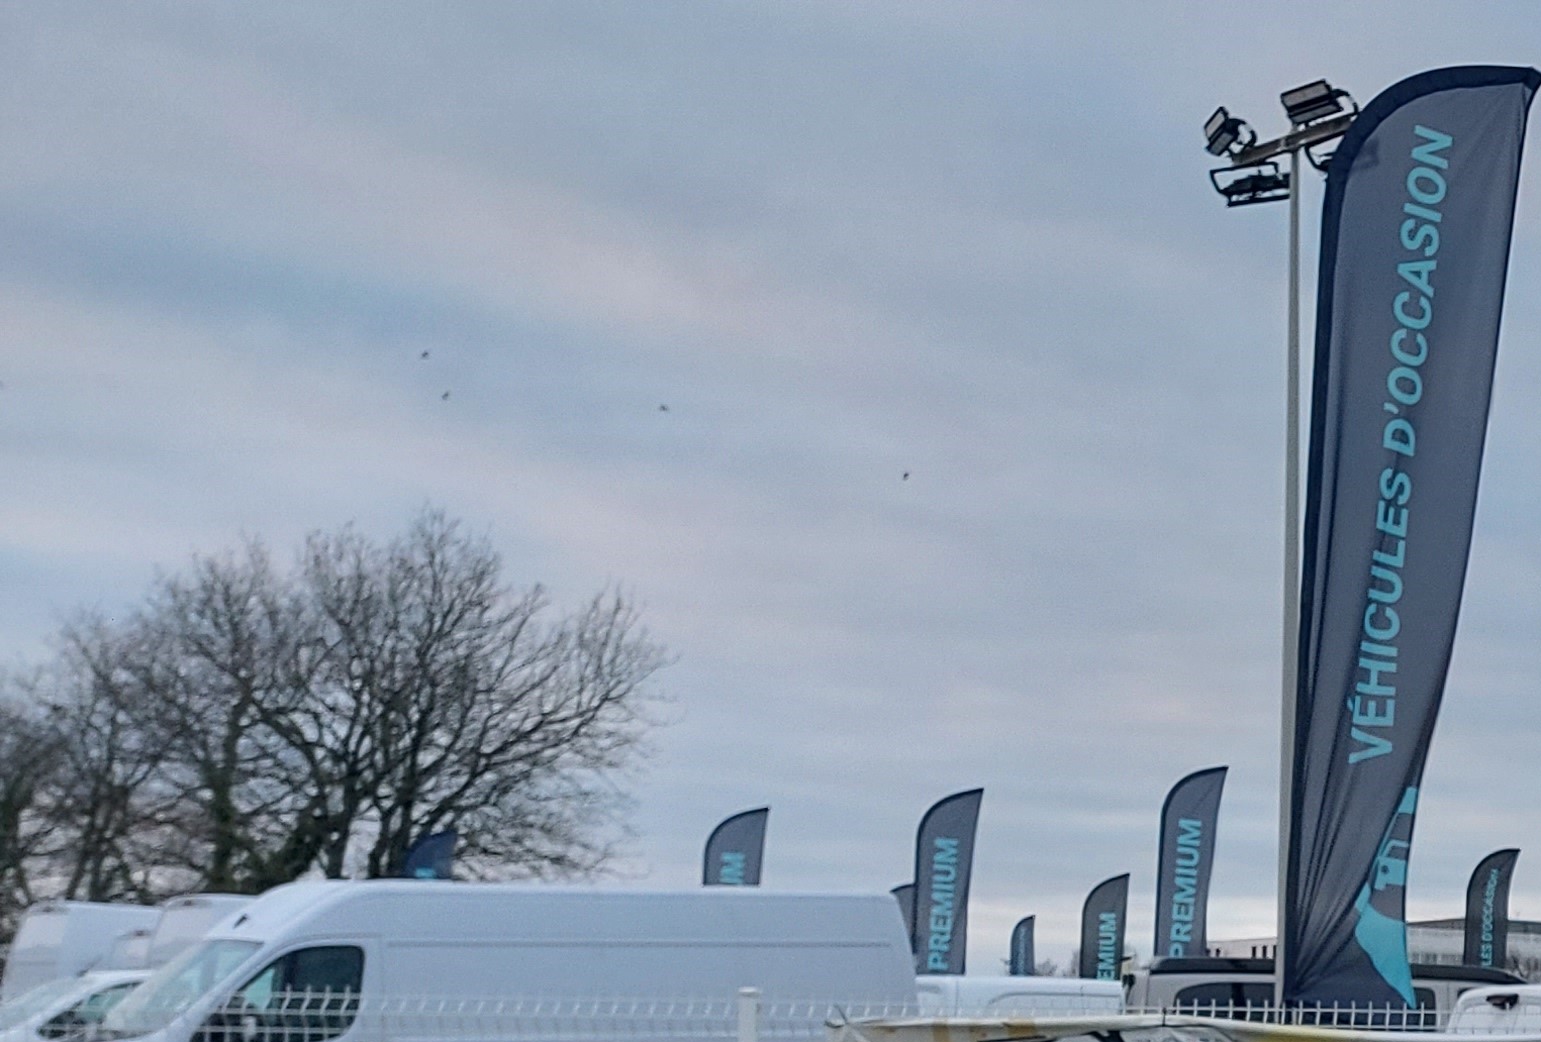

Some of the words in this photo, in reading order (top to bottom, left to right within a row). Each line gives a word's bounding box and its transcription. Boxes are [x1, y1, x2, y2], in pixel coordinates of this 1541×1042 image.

[1349, 469, 1413, 766] VÉHICULES
[1384, 124, 1453, 458] D'OCCASION
[927, 837, 960, 974] PREMIUM
[1172, 818, 1202, 958] PREMIUM
